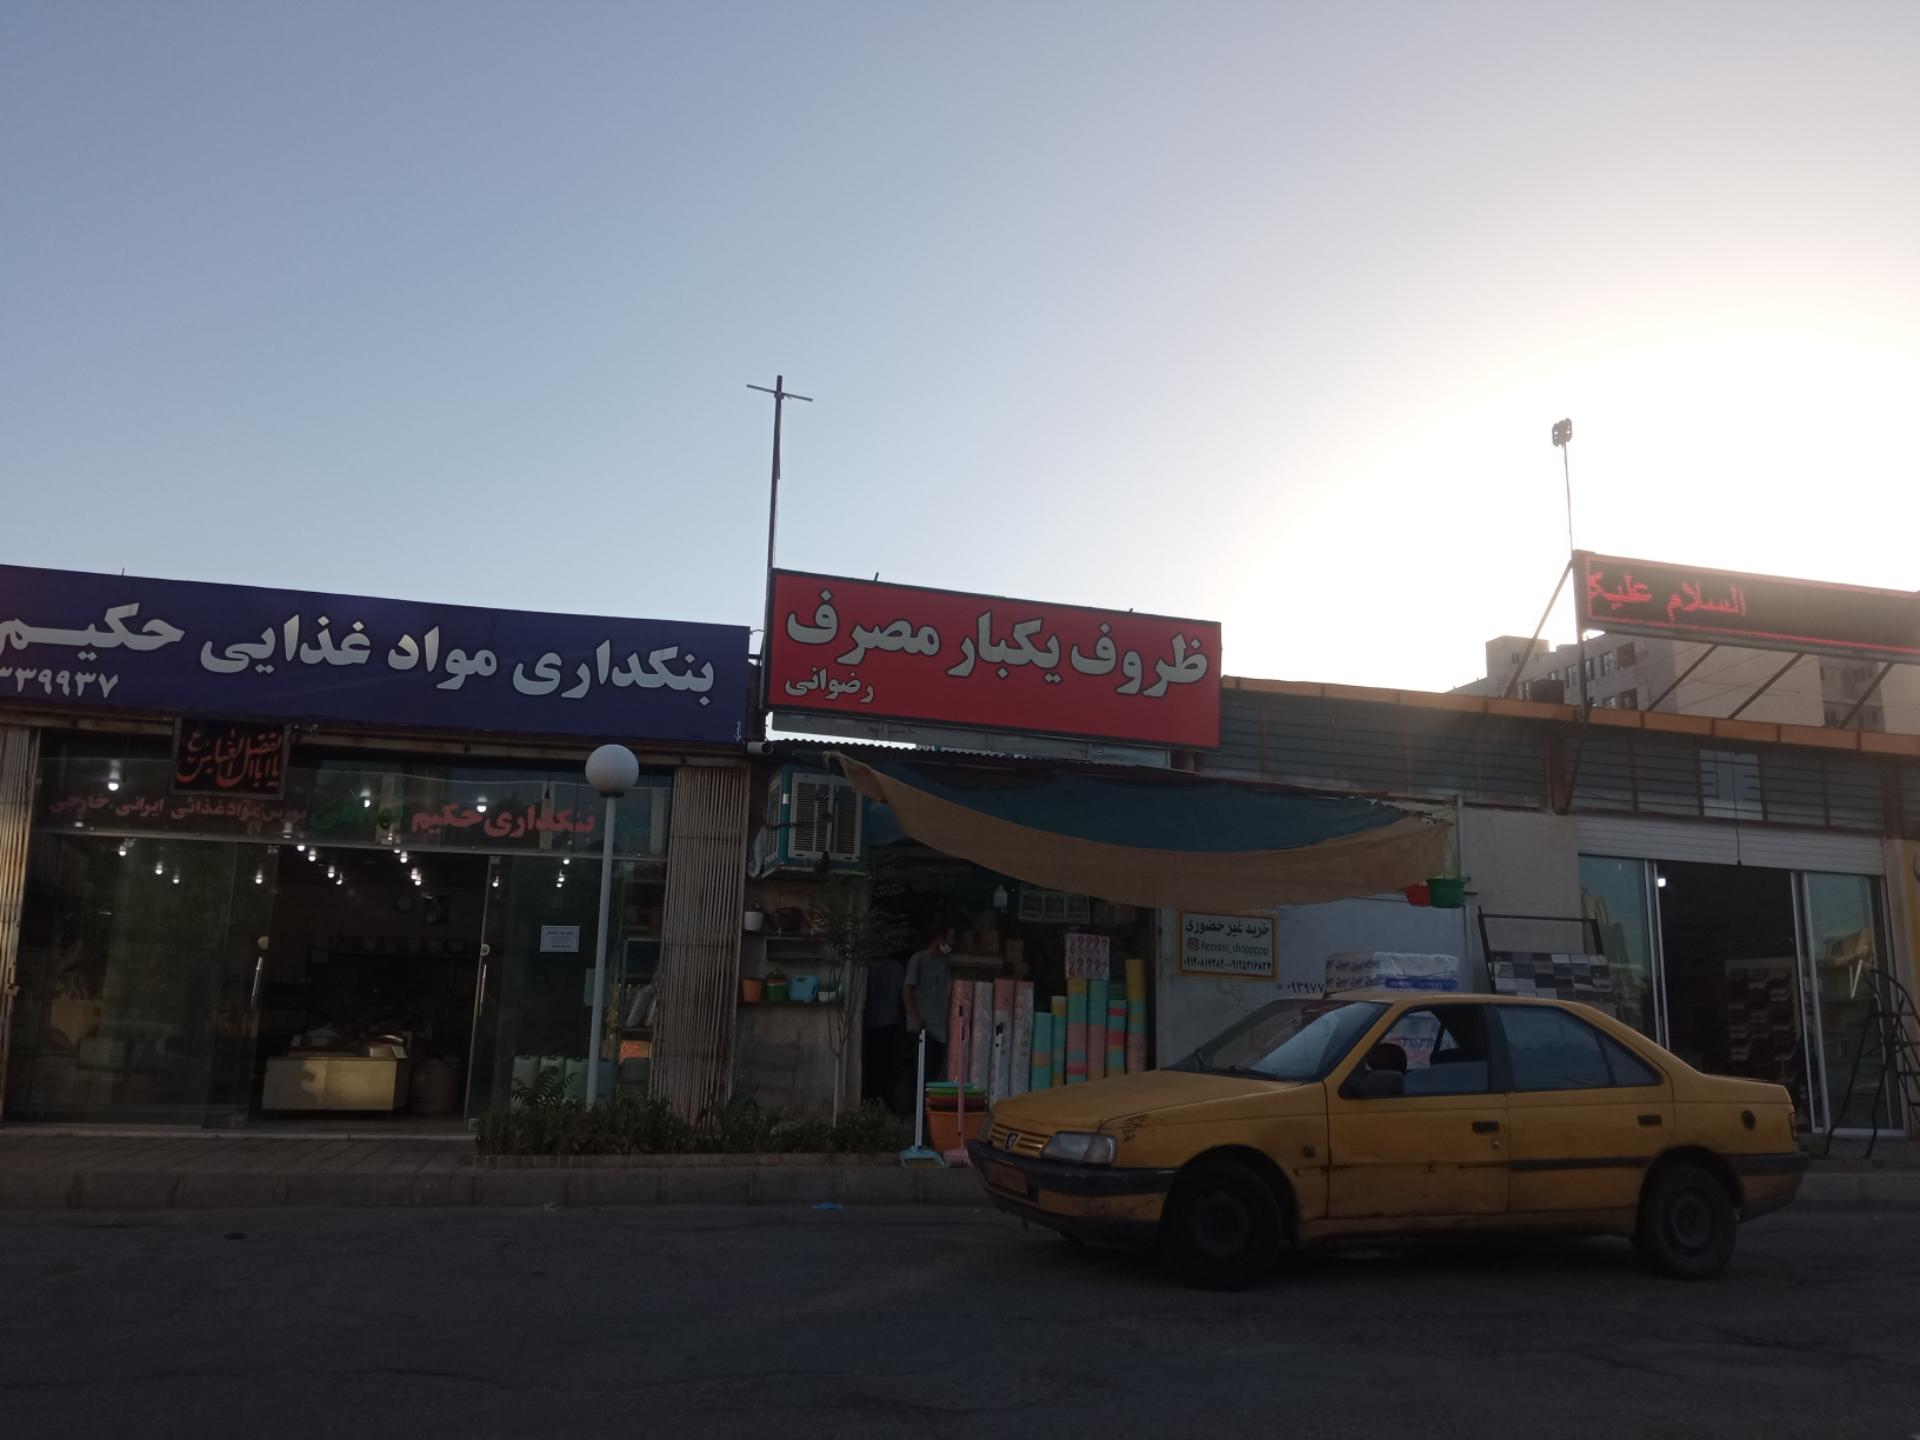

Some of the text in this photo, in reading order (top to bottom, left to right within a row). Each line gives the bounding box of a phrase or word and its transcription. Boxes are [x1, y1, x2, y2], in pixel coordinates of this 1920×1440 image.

[1666, 578, 1746, 622] السلام
[0, 602, 714, 706] بنکداری مواد غذایی حکیم
[785, 588, 1208, 698] ظروف یکبار مصرف
[785, 667, 873, 703] رضوانی
[114, 794, 164, 818] ایرانی
[411, 803, 483, 834] حکیم
[483, 805, 596, 839] بنکداری
[1185, 919, 1269, 938] خرید غیر حضوری
